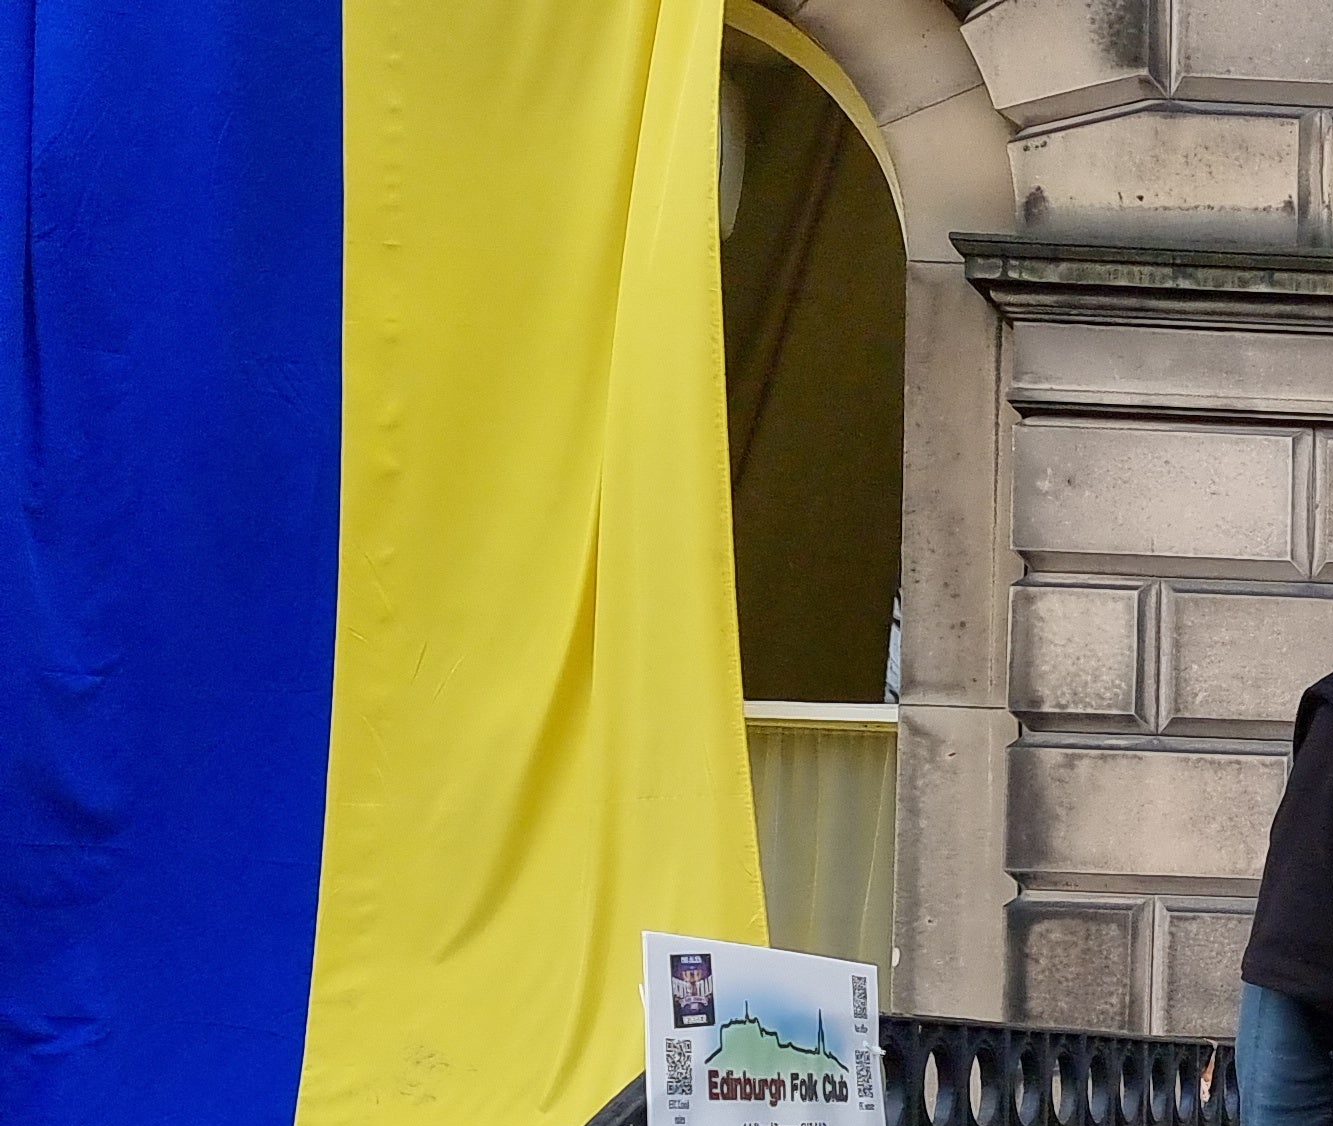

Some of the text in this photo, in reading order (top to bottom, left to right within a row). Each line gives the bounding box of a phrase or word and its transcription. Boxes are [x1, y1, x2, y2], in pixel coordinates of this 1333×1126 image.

[708, 1069, 849, 1107] Edinburgh Folk Club
